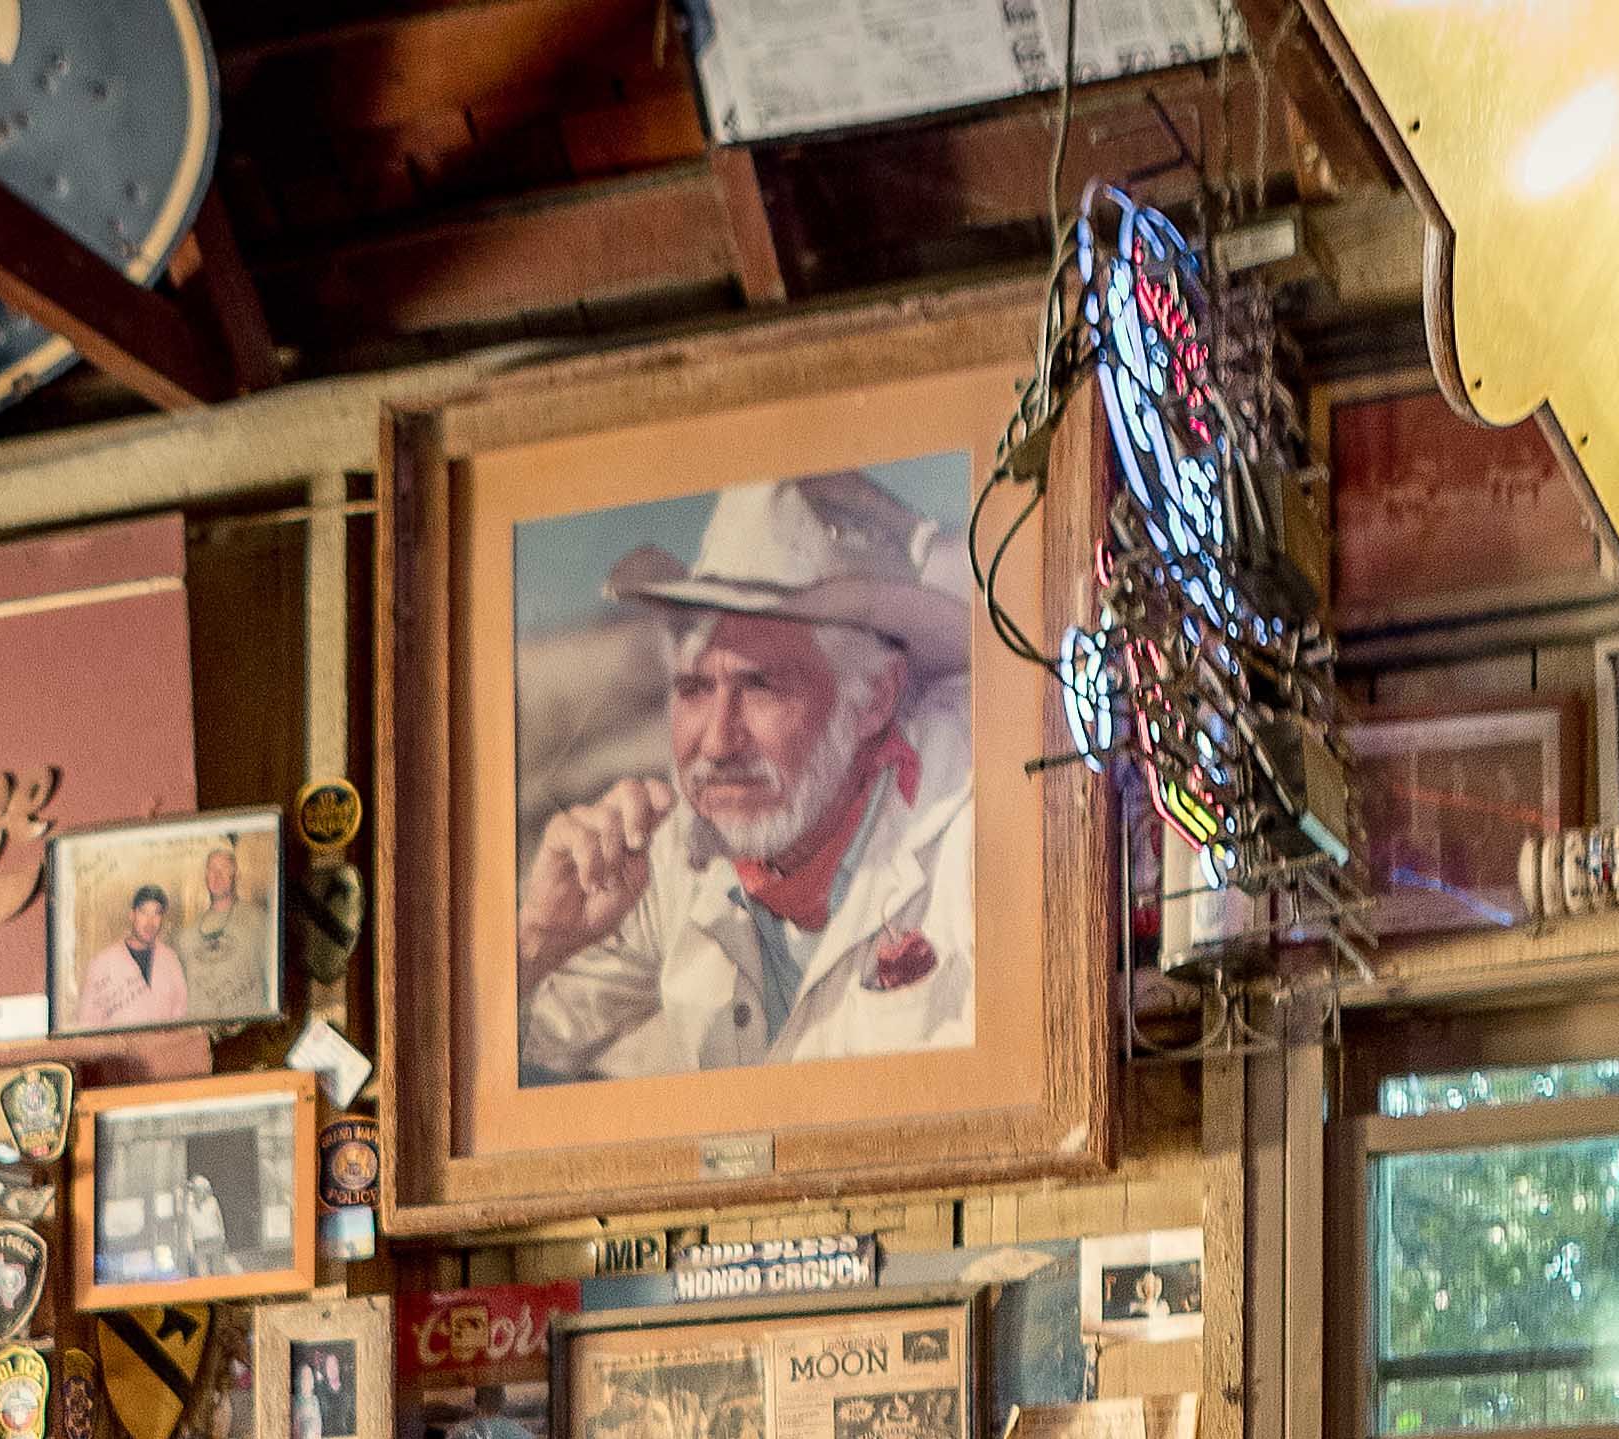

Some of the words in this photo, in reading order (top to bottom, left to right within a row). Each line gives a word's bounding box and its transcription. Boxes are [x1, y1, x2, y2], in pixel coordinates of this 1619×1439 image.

[674, 1261, 762, 1300] HONDO
[768, 1253, 871, 1293] CROUCH
[789, 1348, 889, 1383] MOON
